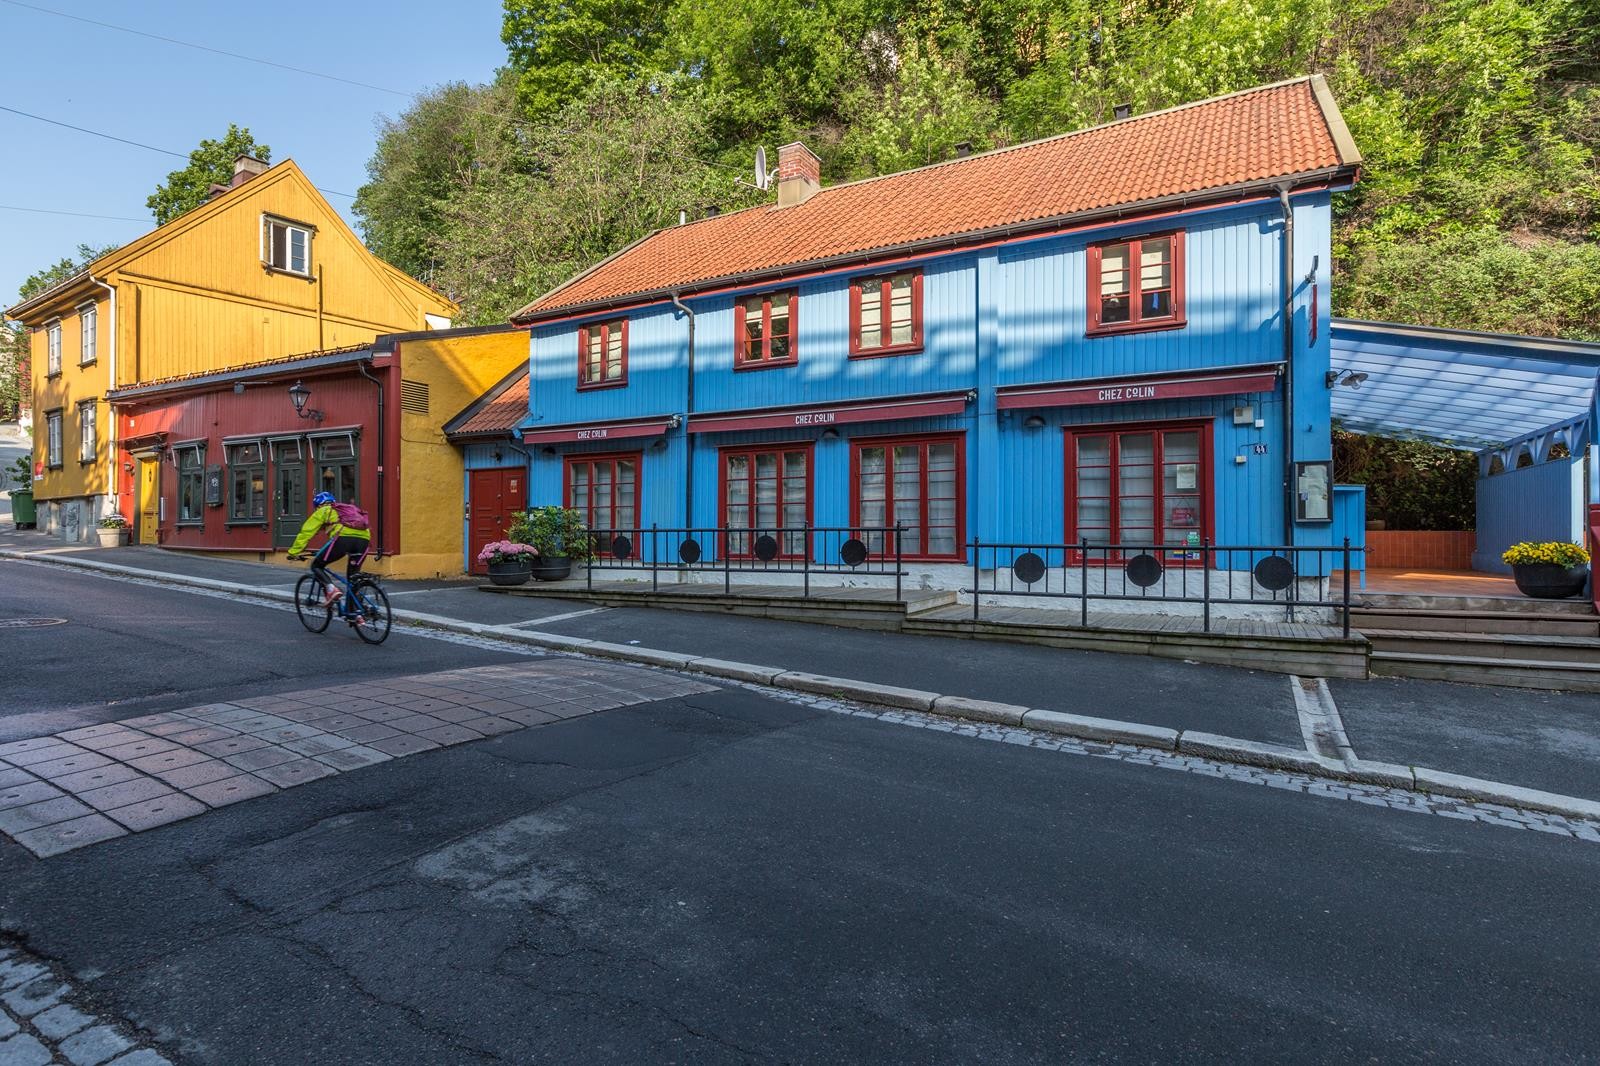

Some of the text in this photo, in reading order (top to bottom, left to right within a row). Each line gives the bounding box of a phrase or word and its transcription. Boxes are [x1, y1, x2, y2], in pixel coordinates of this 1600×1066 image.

[1098, 389, 1122, 401] CHEZ
[795, 415, 812, 424] CHEZ
[577, 430, 590, 439] CHEZ
